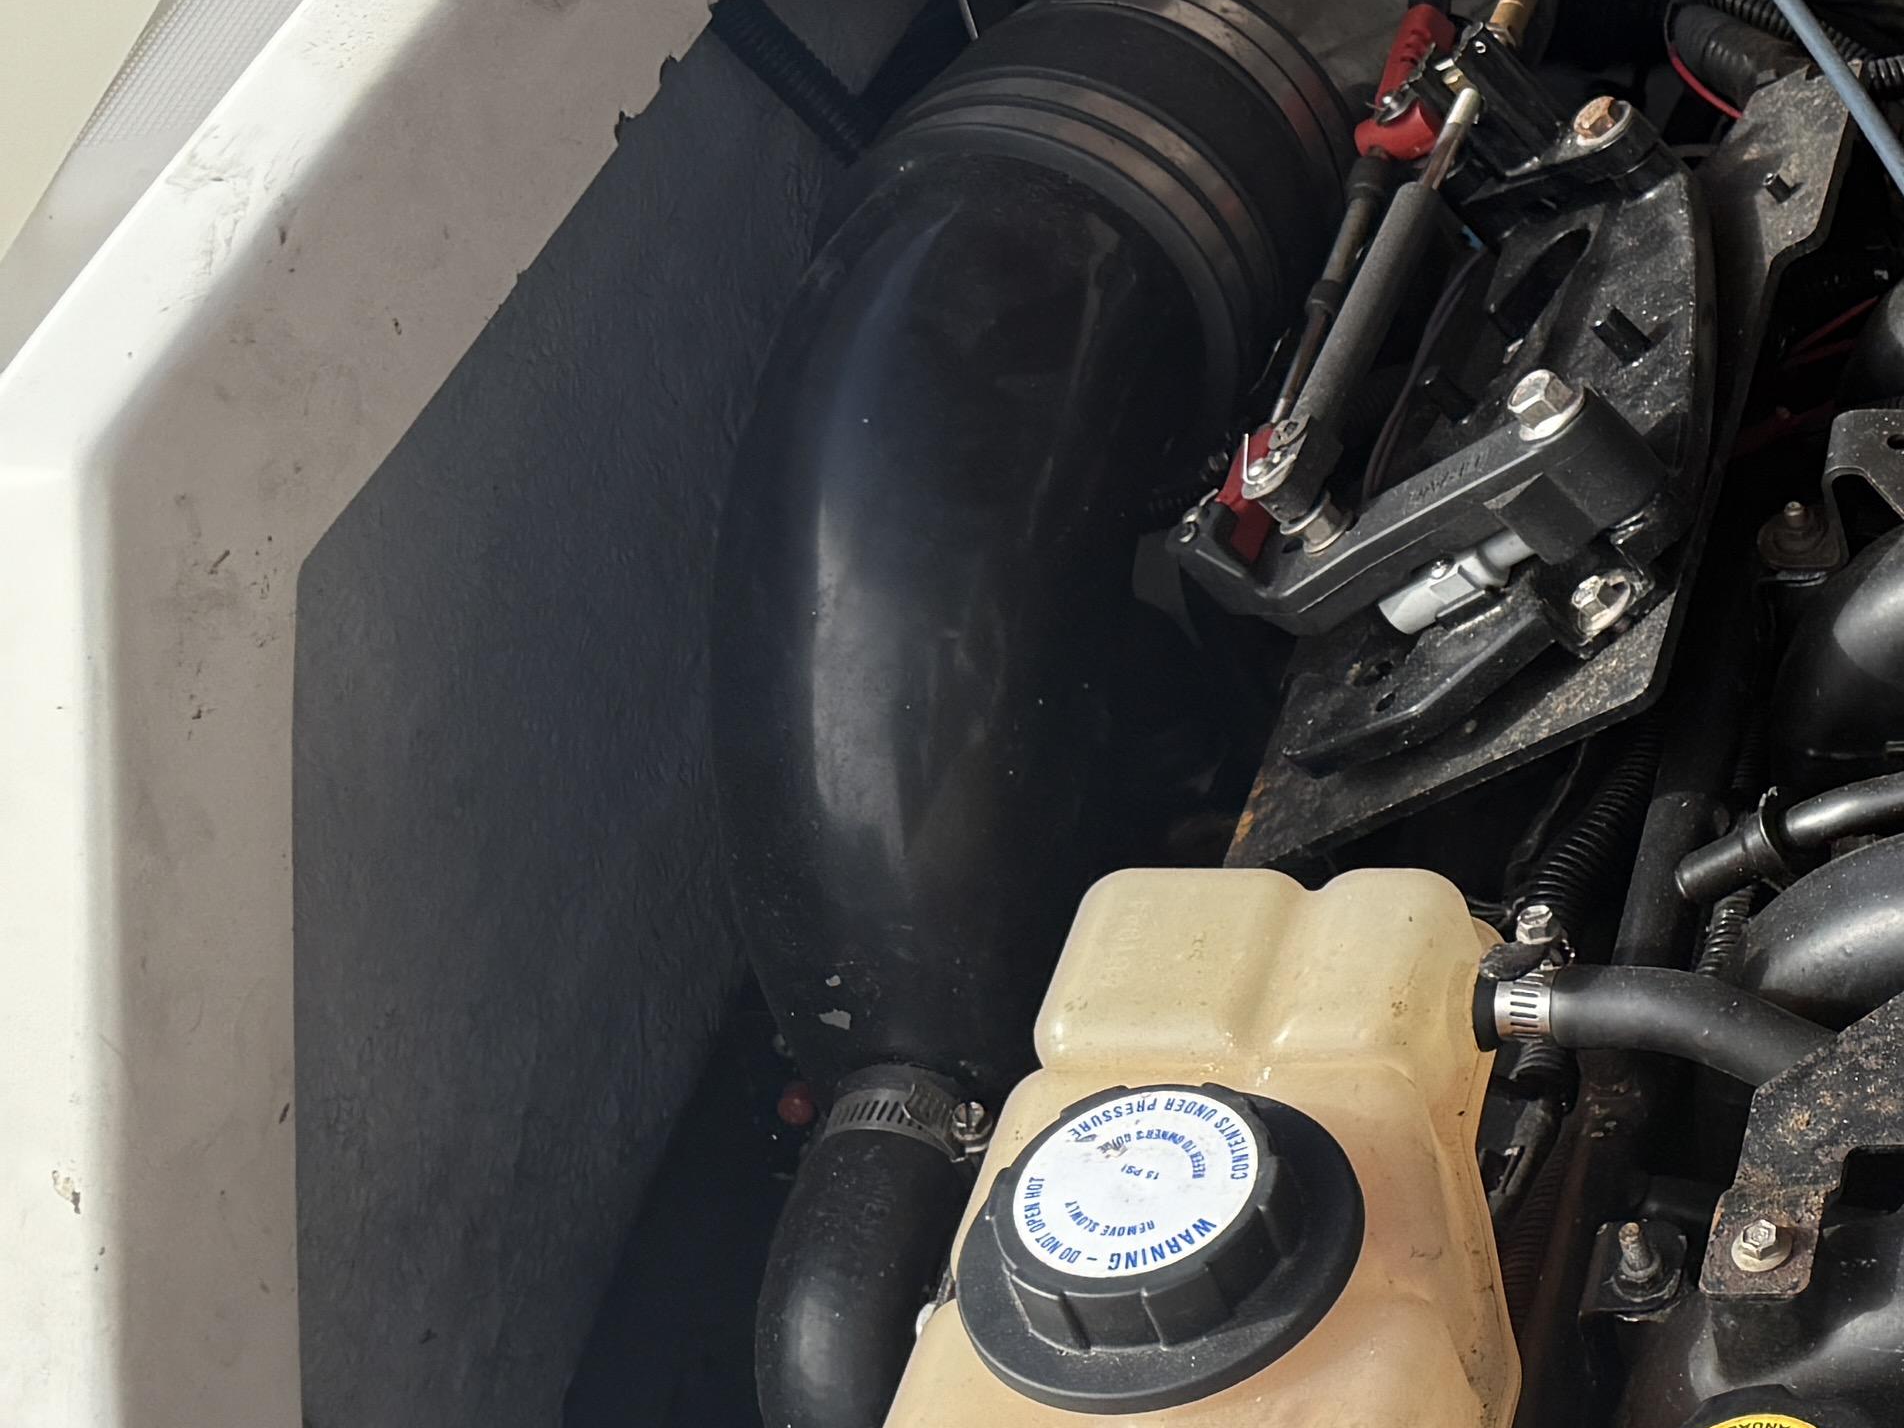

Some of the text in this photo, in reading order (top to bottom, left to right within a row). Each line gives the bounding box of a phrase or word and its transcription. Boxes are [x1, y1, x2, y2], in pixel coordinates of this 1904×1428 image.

[1069, 1097, 1250, 1180] CONTENTS UNDER PRESSURE
[1121, 1163, 1160, 1181] 15 PSI
[1186, 1150, 1207, 1180] REFER
[1023, 1176, 1045, 1200] HOT
[1023, 1198, 1045, 1234] OPEN
[1064, 1200, 1155, 1237] REMOVE SLOWLY
[1034, 1228, 1060, 1254] NOT
[1059, 1246, 1080, 1264] DO
[1108, 1217, 1218, 1271] WARNING
